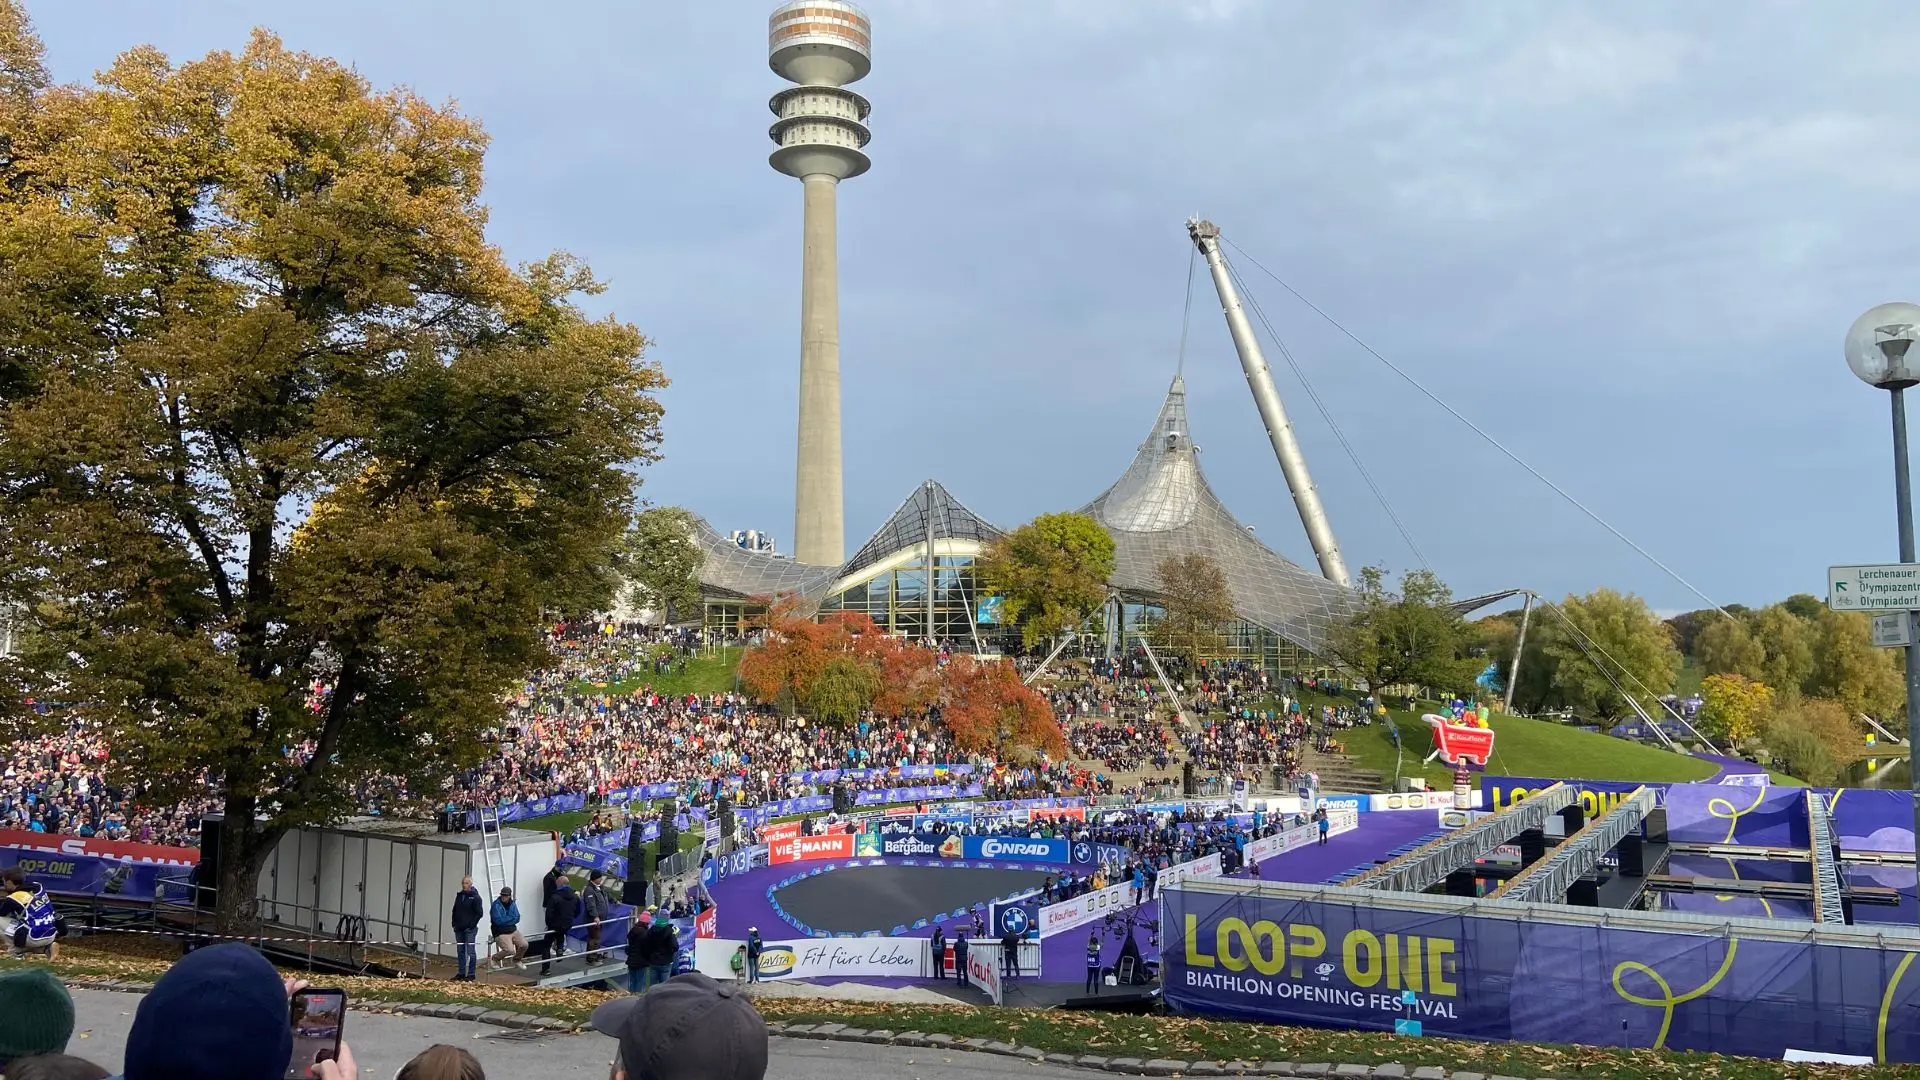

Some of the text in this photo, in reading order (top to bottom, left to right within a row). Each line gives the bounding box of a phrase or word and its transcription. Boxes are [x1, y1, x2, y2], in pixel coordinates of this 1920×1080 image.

[1859, 569, 1917, 579] Lerchenauer
[1860, 595, 1918, 607] Olympiadorf
[1316, 798, 1358, 809] CONRAD
[775, 838, 843, 860] VIESSMANN
[885, 837, 935, 855] Bergader
[982, 838, 1050, 858] CONRAD
[730, 852, 746, 873] iX3
[801, 944, 915, 969] Fit fürs Leben
[1185, 913, 1457, 997] LOOP ONE
[1186, 971, 1458, 1019] BIATHLON OPENING FESIVAL
